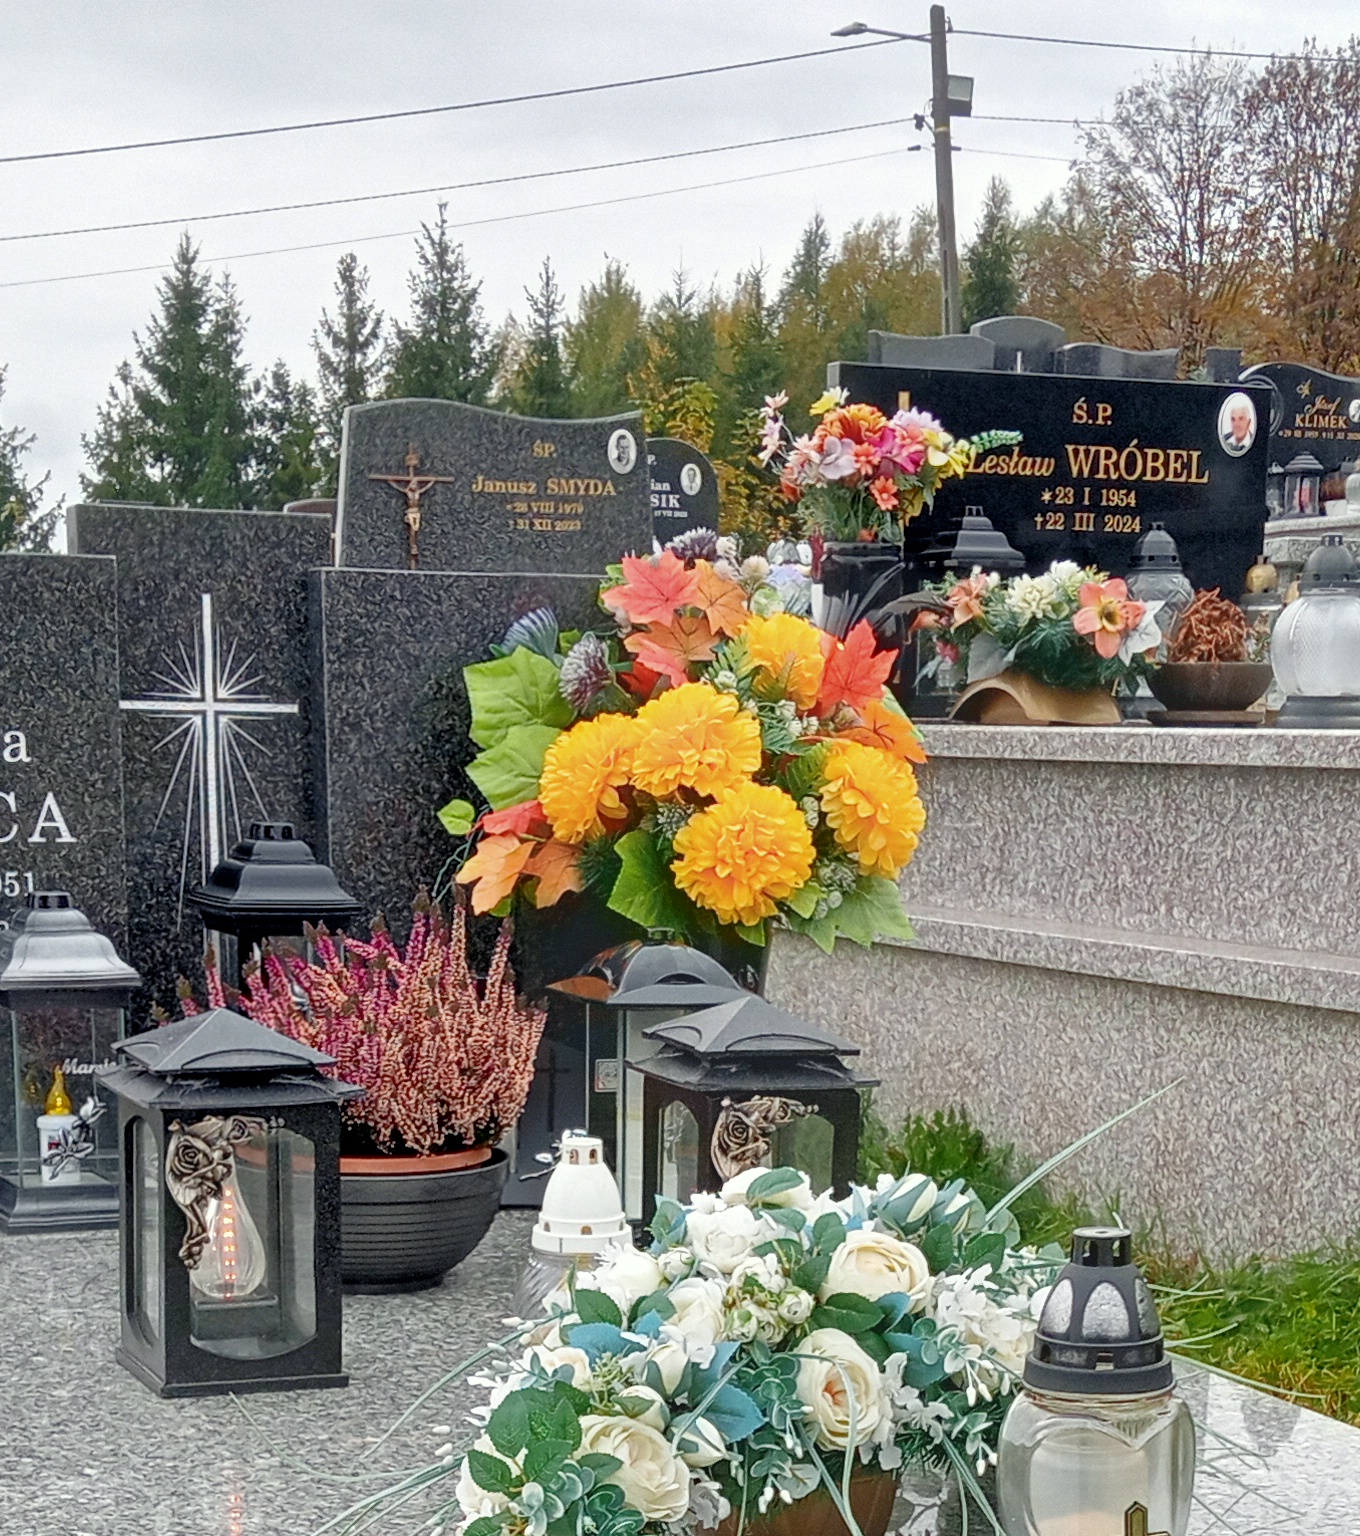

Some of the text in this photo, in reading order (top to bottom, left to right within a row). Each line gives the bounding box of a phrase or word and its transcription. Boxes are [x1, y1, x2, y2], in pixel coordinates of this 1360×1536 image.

[1072, 397, 1113, 426] Ś.P.
[1294, 413, 1349, 429] KLIMEK
[966, 438, 1211, 484] Lesław WRÓBEL
[471, 472, 618, 496] Janusz SMYDA
[650, 478, 672, 492] ian
[649, 493, 681, 509] SIK
[1054, 486, 1137, 508] 23 I 1954
[1045, 513, 1142, 534] 22 III 2024
